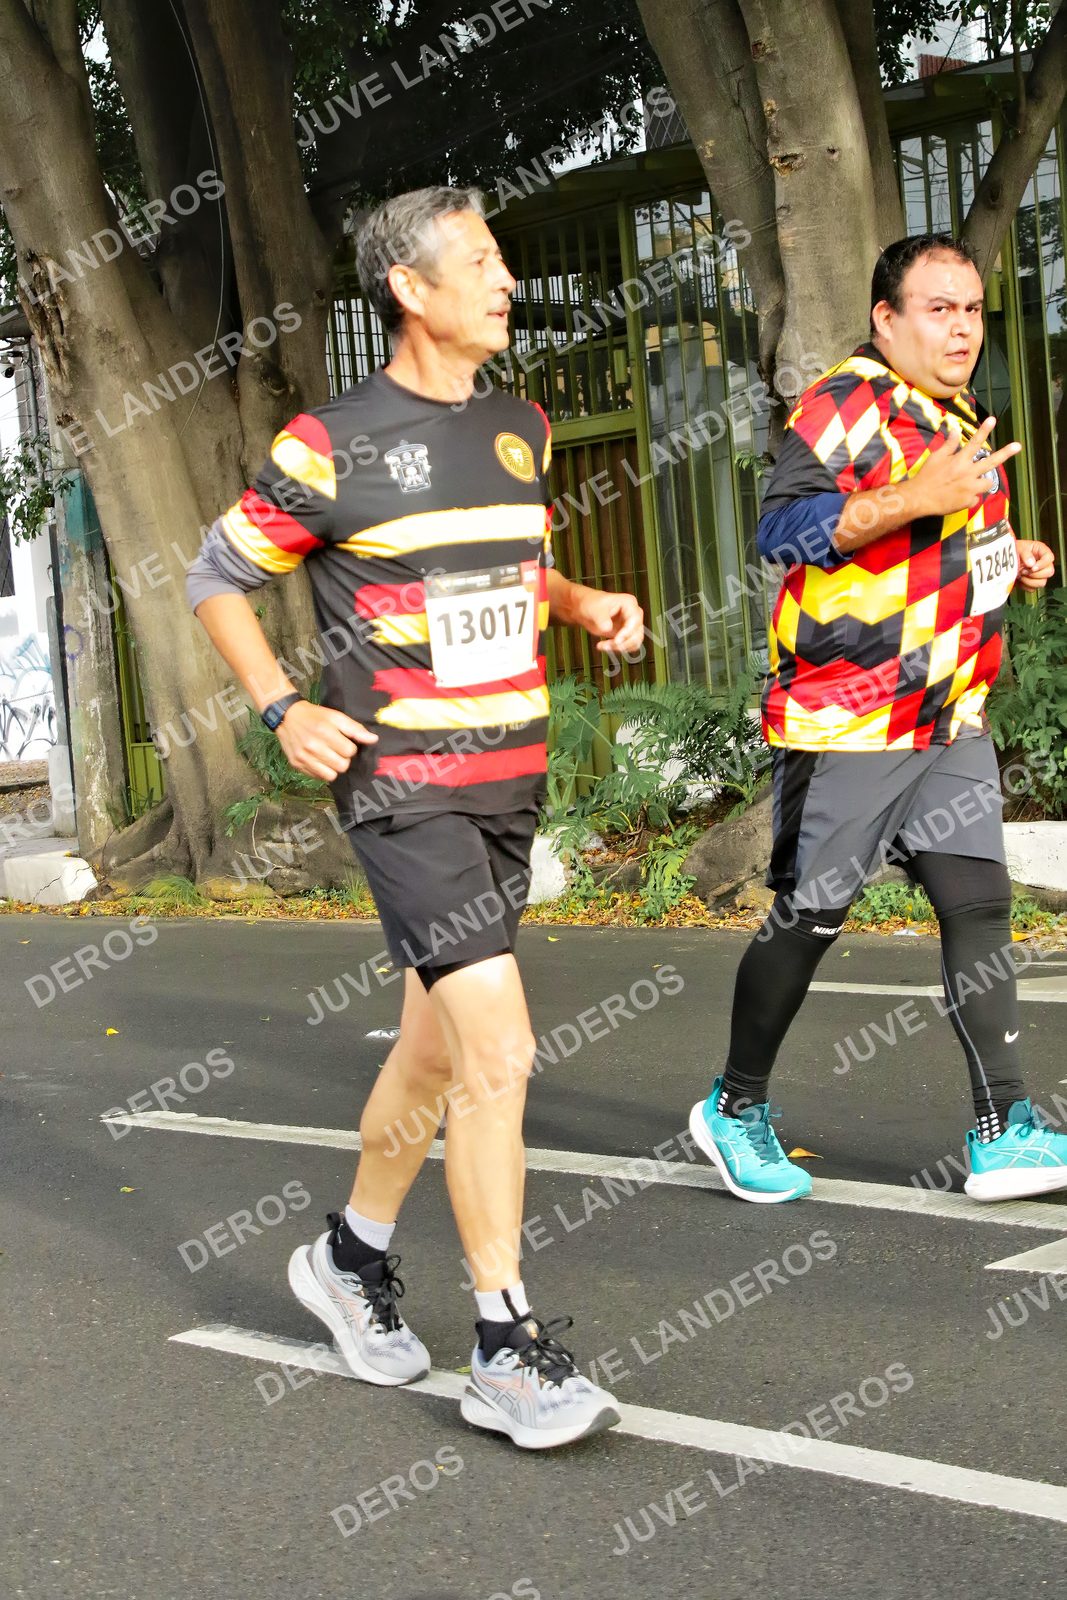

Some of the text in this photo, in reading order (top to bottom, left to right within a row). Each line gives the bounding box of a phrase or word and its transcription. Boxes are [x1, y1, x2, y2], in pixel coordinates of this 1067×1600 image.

[975, 543, 1014, 584] 12846
[437, 600, 527, 646] 13017
[812, 925, 837, 935] NIKE
